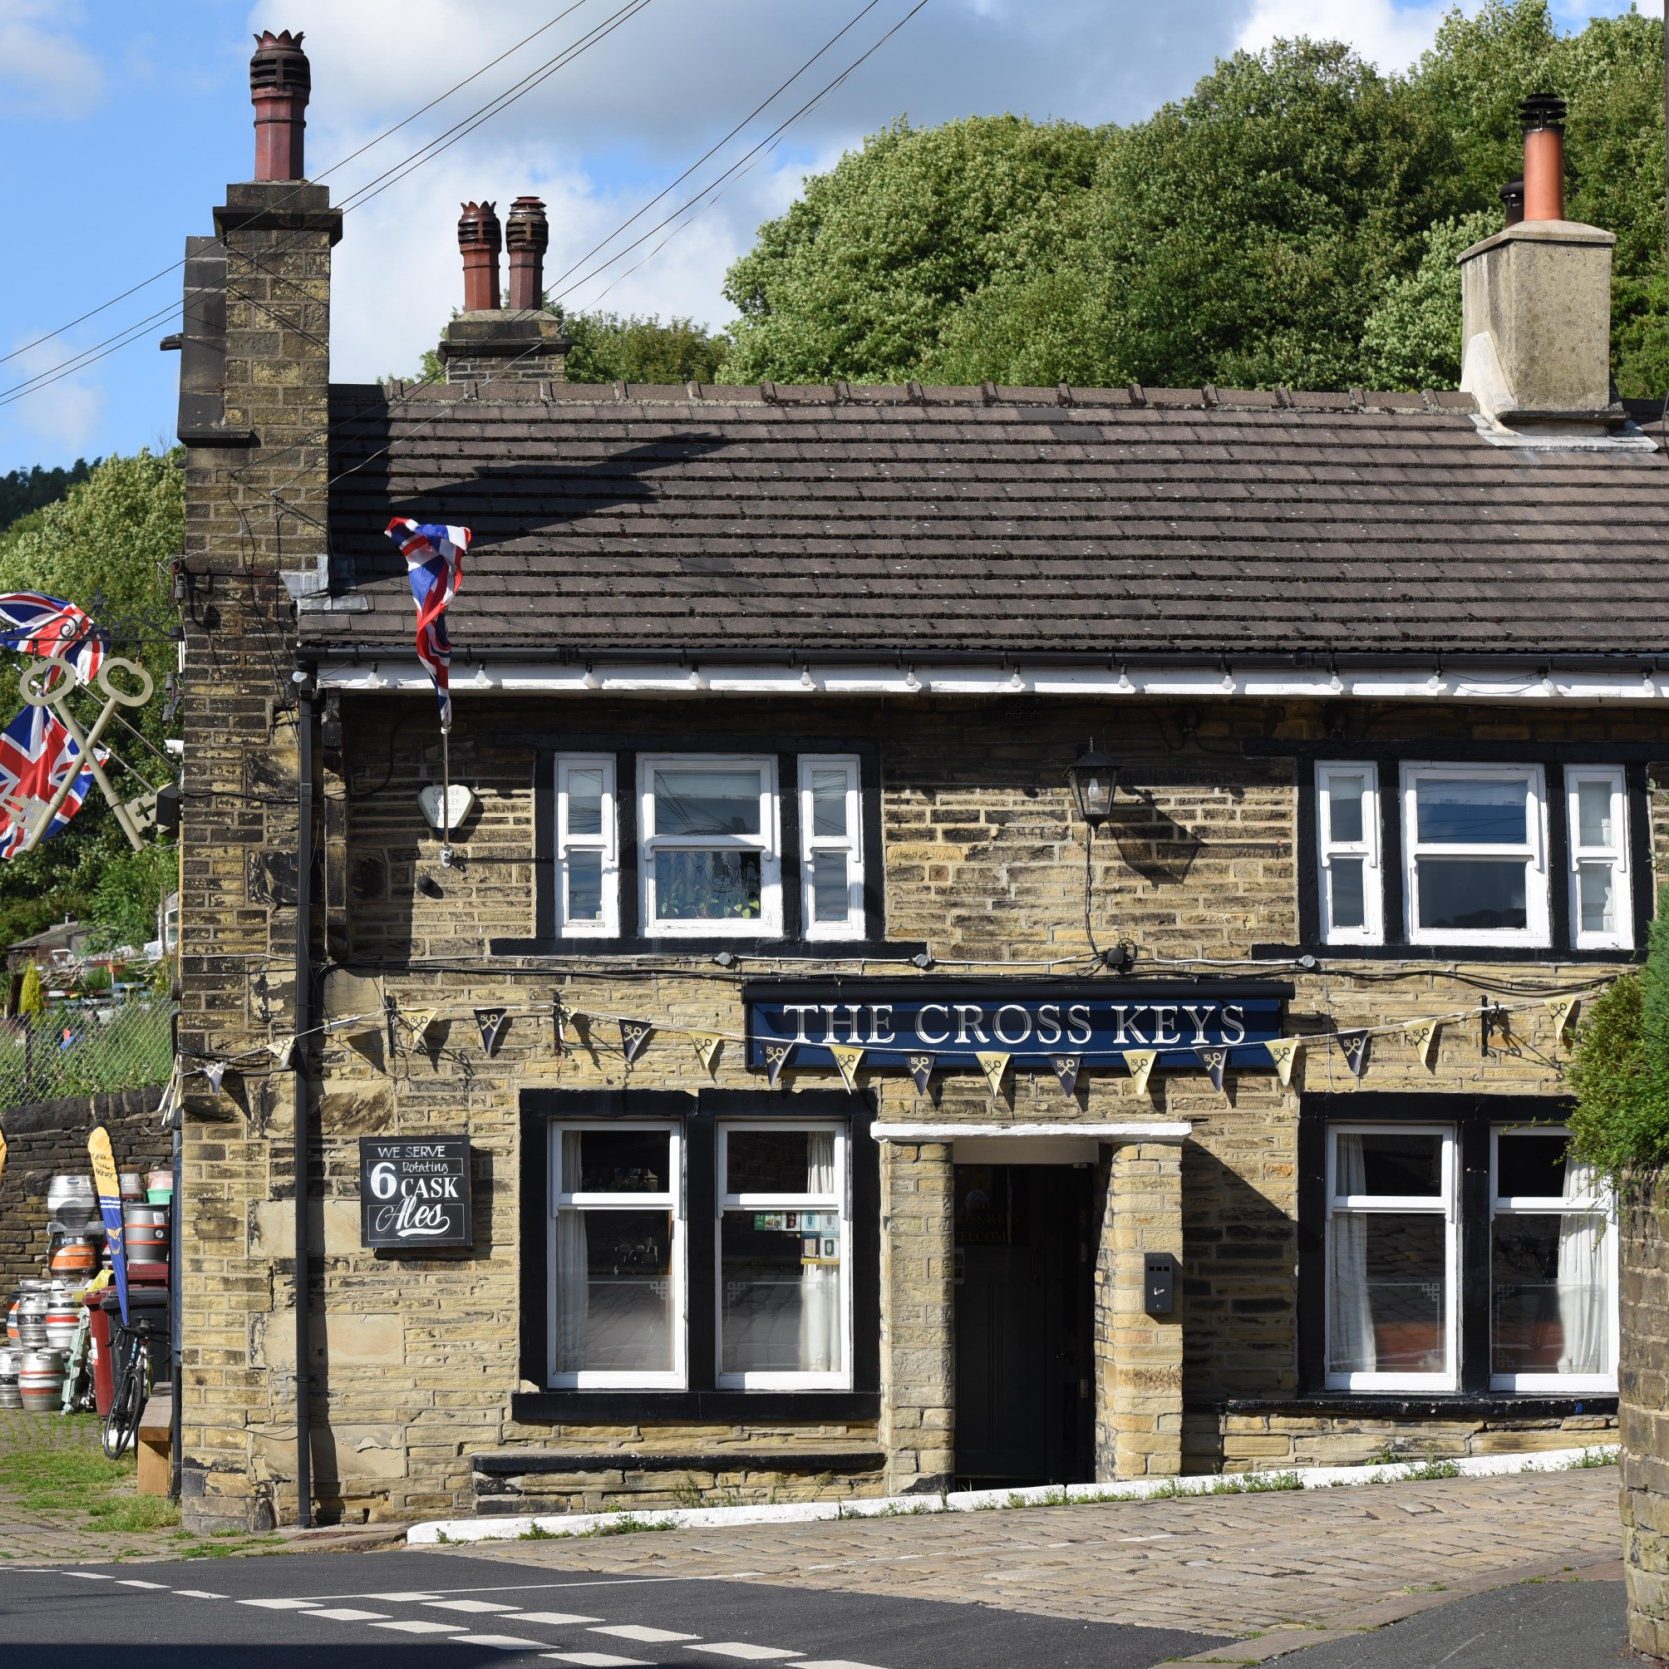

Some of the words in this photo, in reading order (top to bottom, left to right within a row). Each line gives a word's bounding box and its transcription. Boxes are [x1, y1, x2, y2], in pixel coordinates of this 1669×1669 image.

[783, 1004, 895, 1043] THE
[914, 1004, 1092, 1044] CROSS
[1110, 1005, 1245, 1044] KEYS
[377, 1146, 400, 1158] WE
[405, 1145, 445, 1158] SERVE
[370, 1161, 397, 1199] 6
[402, 1161, 448, 1174] Rotating
[401, 1176, 459, 1199] CASK
[375, 1196, 450, 1237] Ales
